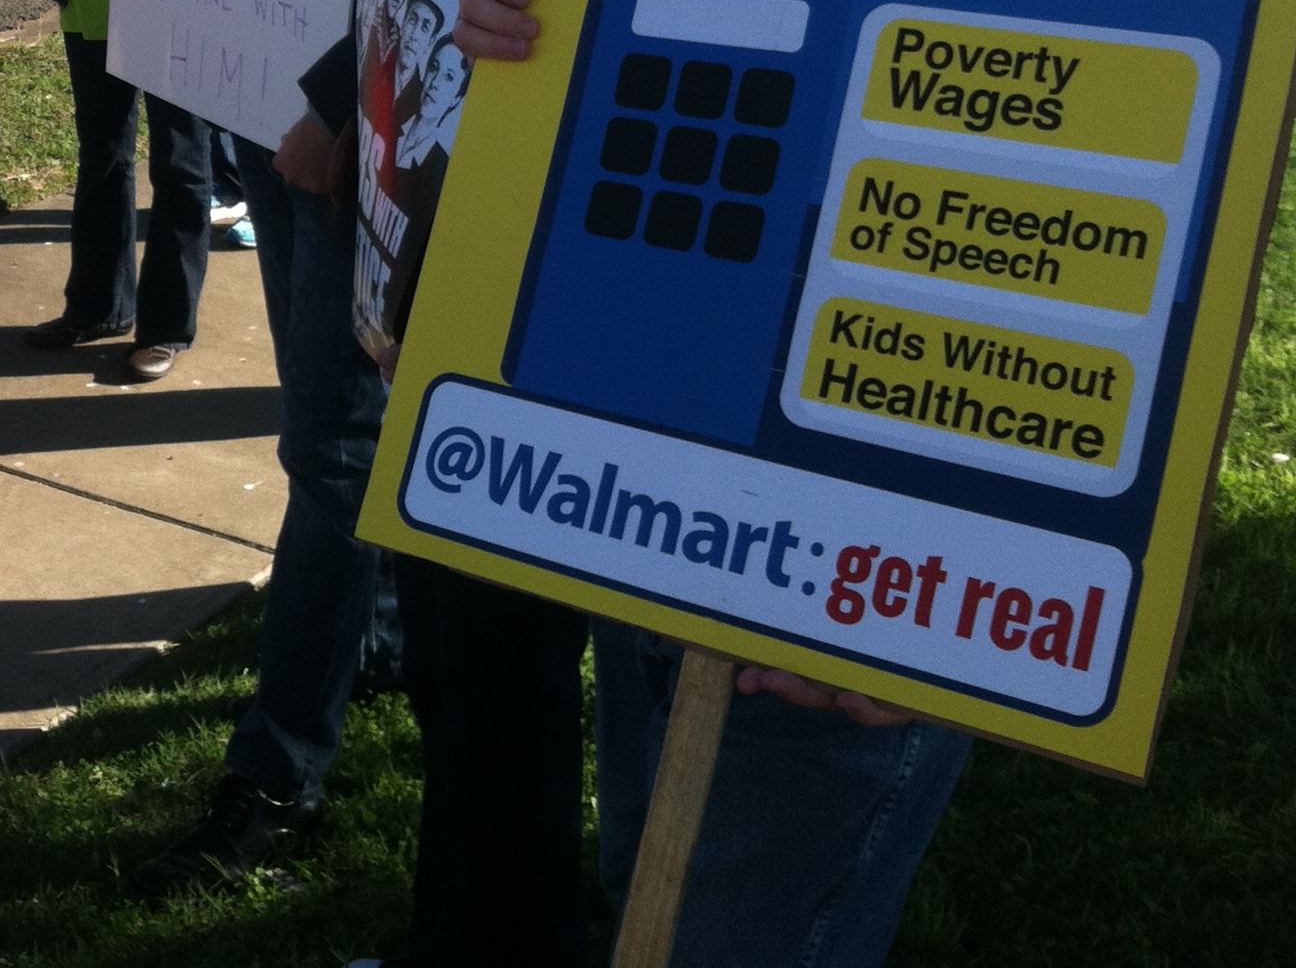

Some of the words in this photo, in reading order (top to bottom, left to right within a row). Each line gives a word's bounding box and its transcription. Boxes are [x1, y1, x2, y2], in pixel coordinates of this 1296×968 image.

[888, 66, 1065, 133] Wages
[890, 26, 1080, 95] Poverty
[849, 221, 894, 254] of
[902, 225, 1062, 285] Speech
[857, 177, 922, 220] No
[935, 190, 1150, 260] Freedom
[828, 309, 927, 361] Kids
[941, 331, 1117, 402] Without
[817, 358, 1106, 460] Healthcare
[824, 543, 948, 630] get
[954, 575, 1107, 672] real
